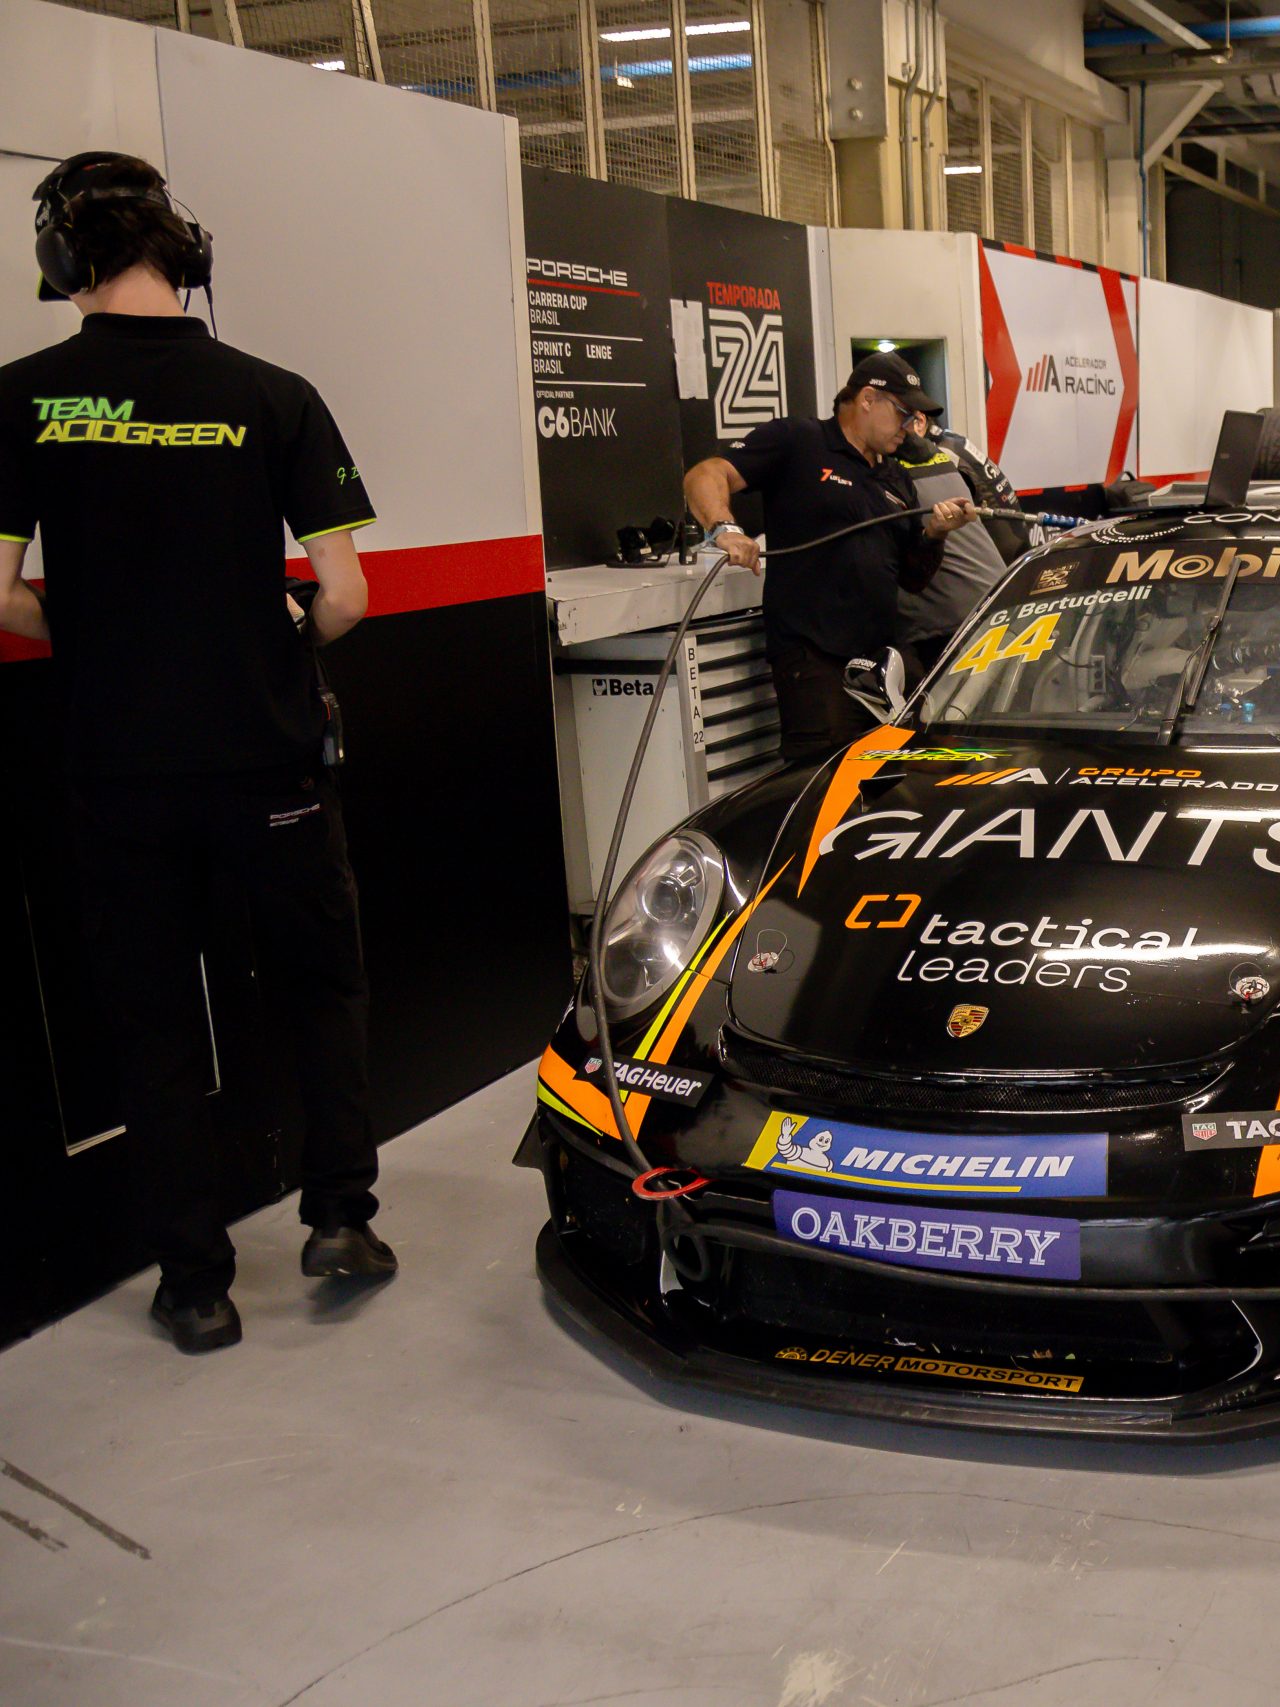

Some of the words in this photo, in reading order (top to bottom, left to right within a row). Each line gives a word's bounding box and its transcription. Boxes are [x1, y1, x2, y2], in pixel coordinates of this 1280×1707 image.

[527, 257, 628, 287] PORSCHE
[529, 290, 569, 309] CARRERA
[570, 296, 587, 311] CUP
[707, 282, 781, 310] TEMPORADA
[530, 309, 560, 326] BRASIL
[532, 340, 564, 356] SPRINT
[533, 358, 564, 374] BRASIL
[555, 390, 574, 399] PARTNER
[33, 397, 135, 421] TEAM
[36, 419, 247, 447] ACIDGREEN
[990, 610, 1010, 626] G.
[1017, 585, 1153, 619] Bertuccelli
[949, 612, 1062, 676] 44
[609, 679, 654, 697] Beta
[1077, 767, 1202, 778] GRUPO
[920, 914, 1199, 960] tactical
[897, 950, 1132, 993] leaders
[839, 1147, 1075, 1178] MICHELIN
[791, 1207, 1061, 1266] OAKBERRY
[808, 1348, 896, 1371] DENER
[898, 1357, 1079, 1390] MOTORSPORT
